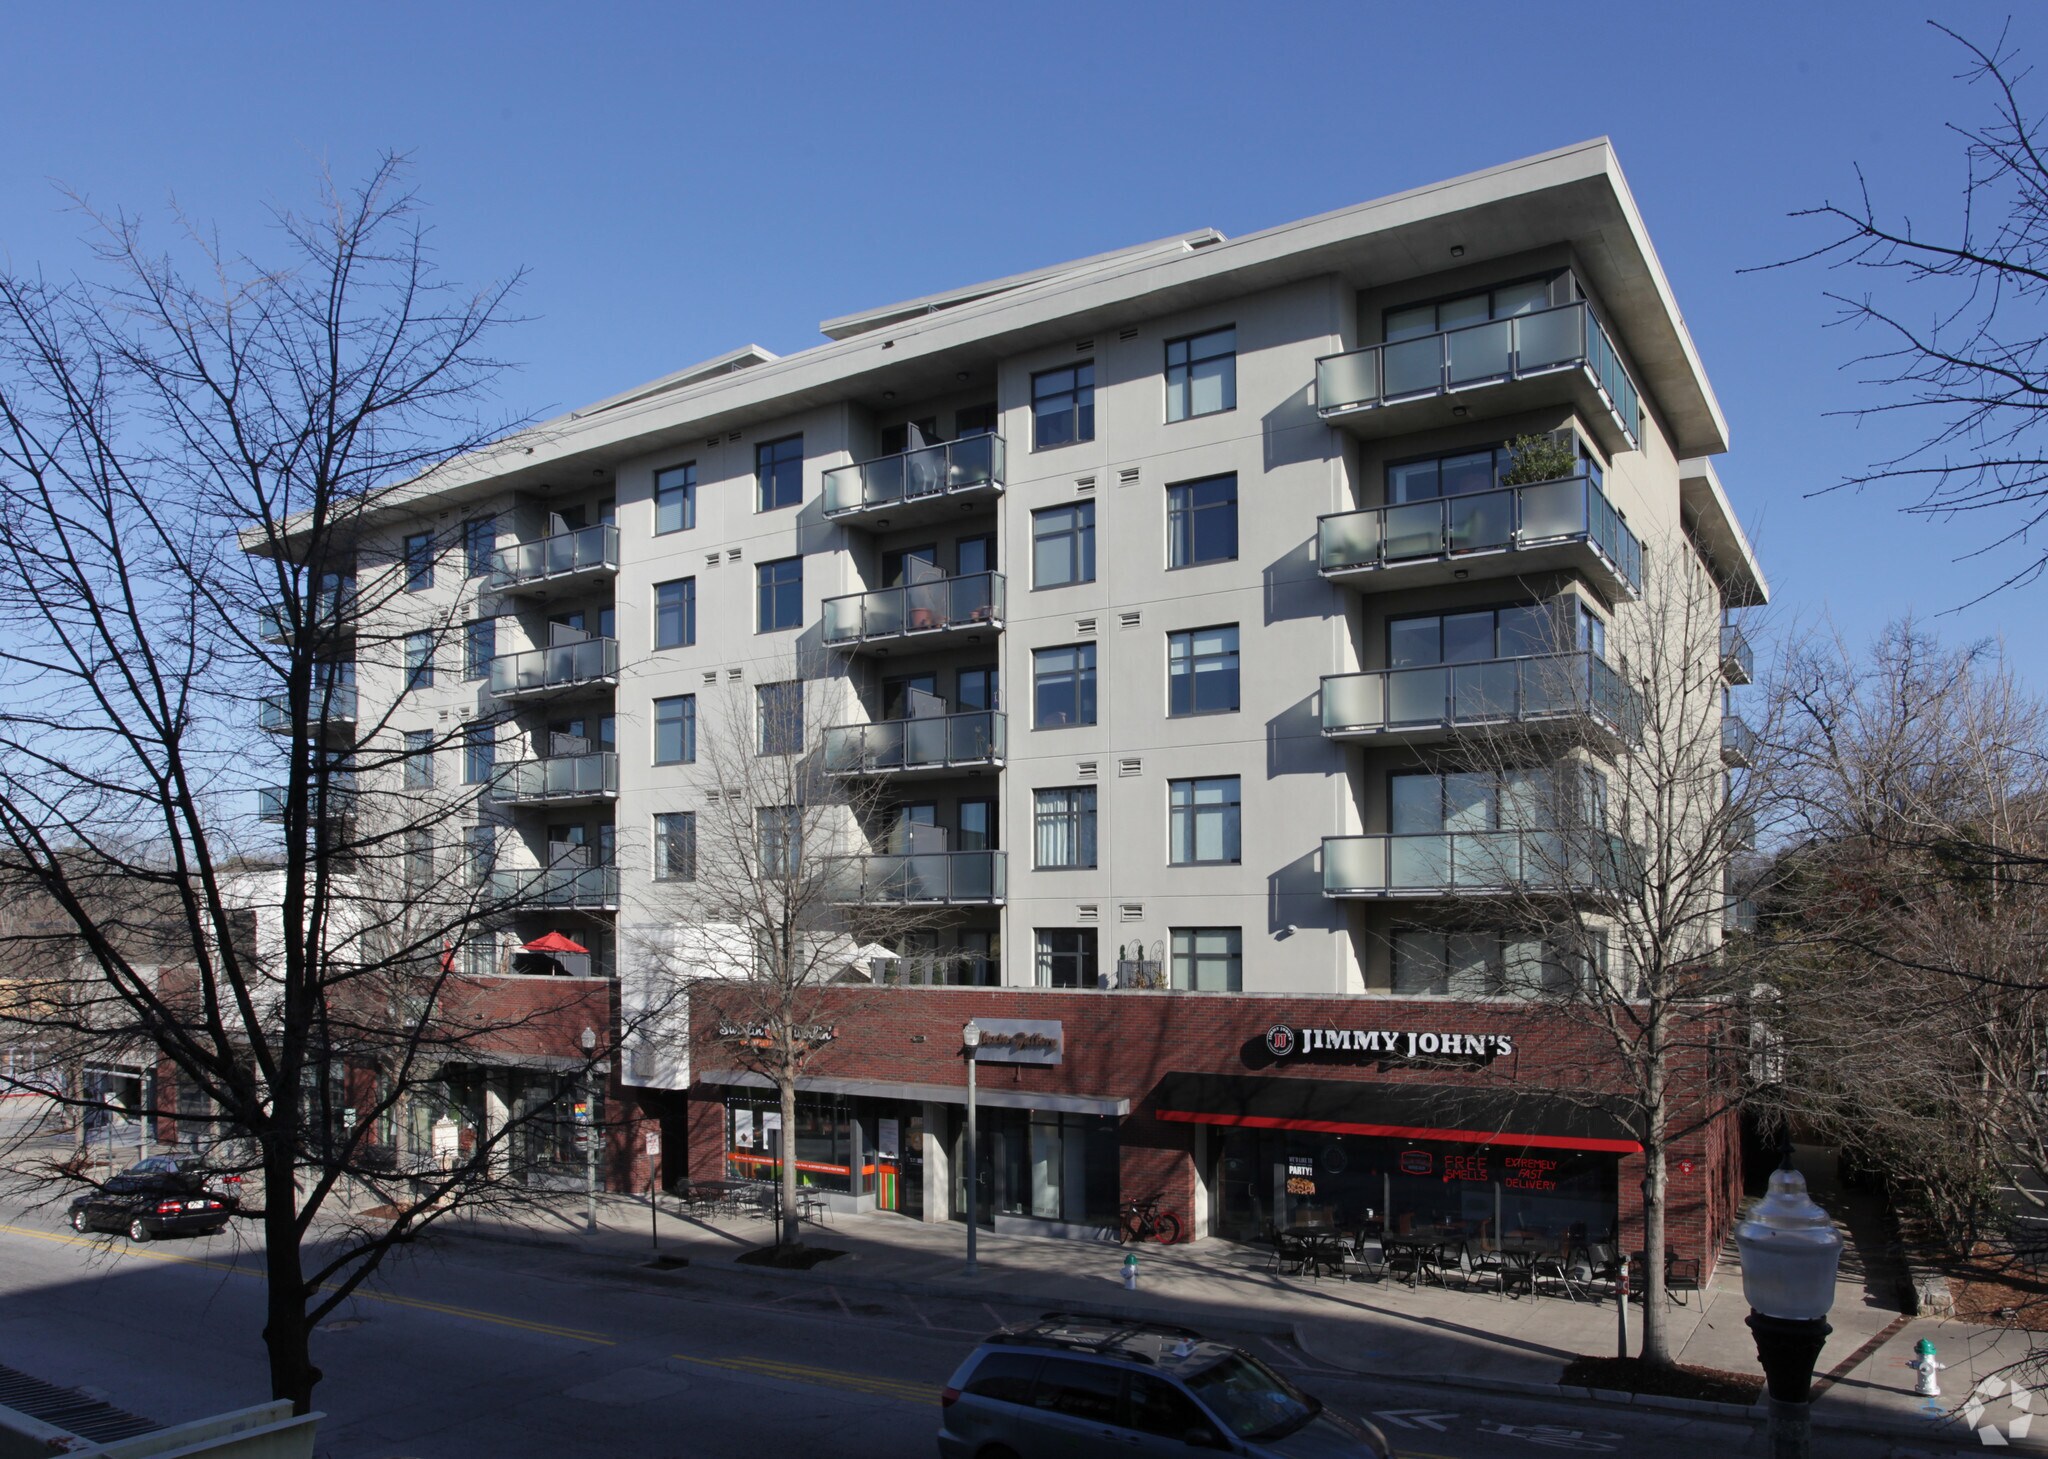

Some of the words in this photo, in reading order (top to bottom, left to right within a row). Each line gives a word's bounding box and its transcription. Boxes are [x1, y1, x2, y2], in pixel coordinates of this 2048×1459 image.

[1302, 1029, 1399, 1054] JIMMY
[1407, 1032, 1512, 1056] JOHN'S
[1444, 1155, 1488, 1171] FREE
[1505, 1157, 1557, 1170] EXTREMELY
[1289, 1165, 1313, 1176] PARTY!
[1446, 1169, 1488, 1181] SMELLS
[1518, 1168, 1543, 1180] FAST
[1505, 1177, 1556, 1191] DELIVERY
